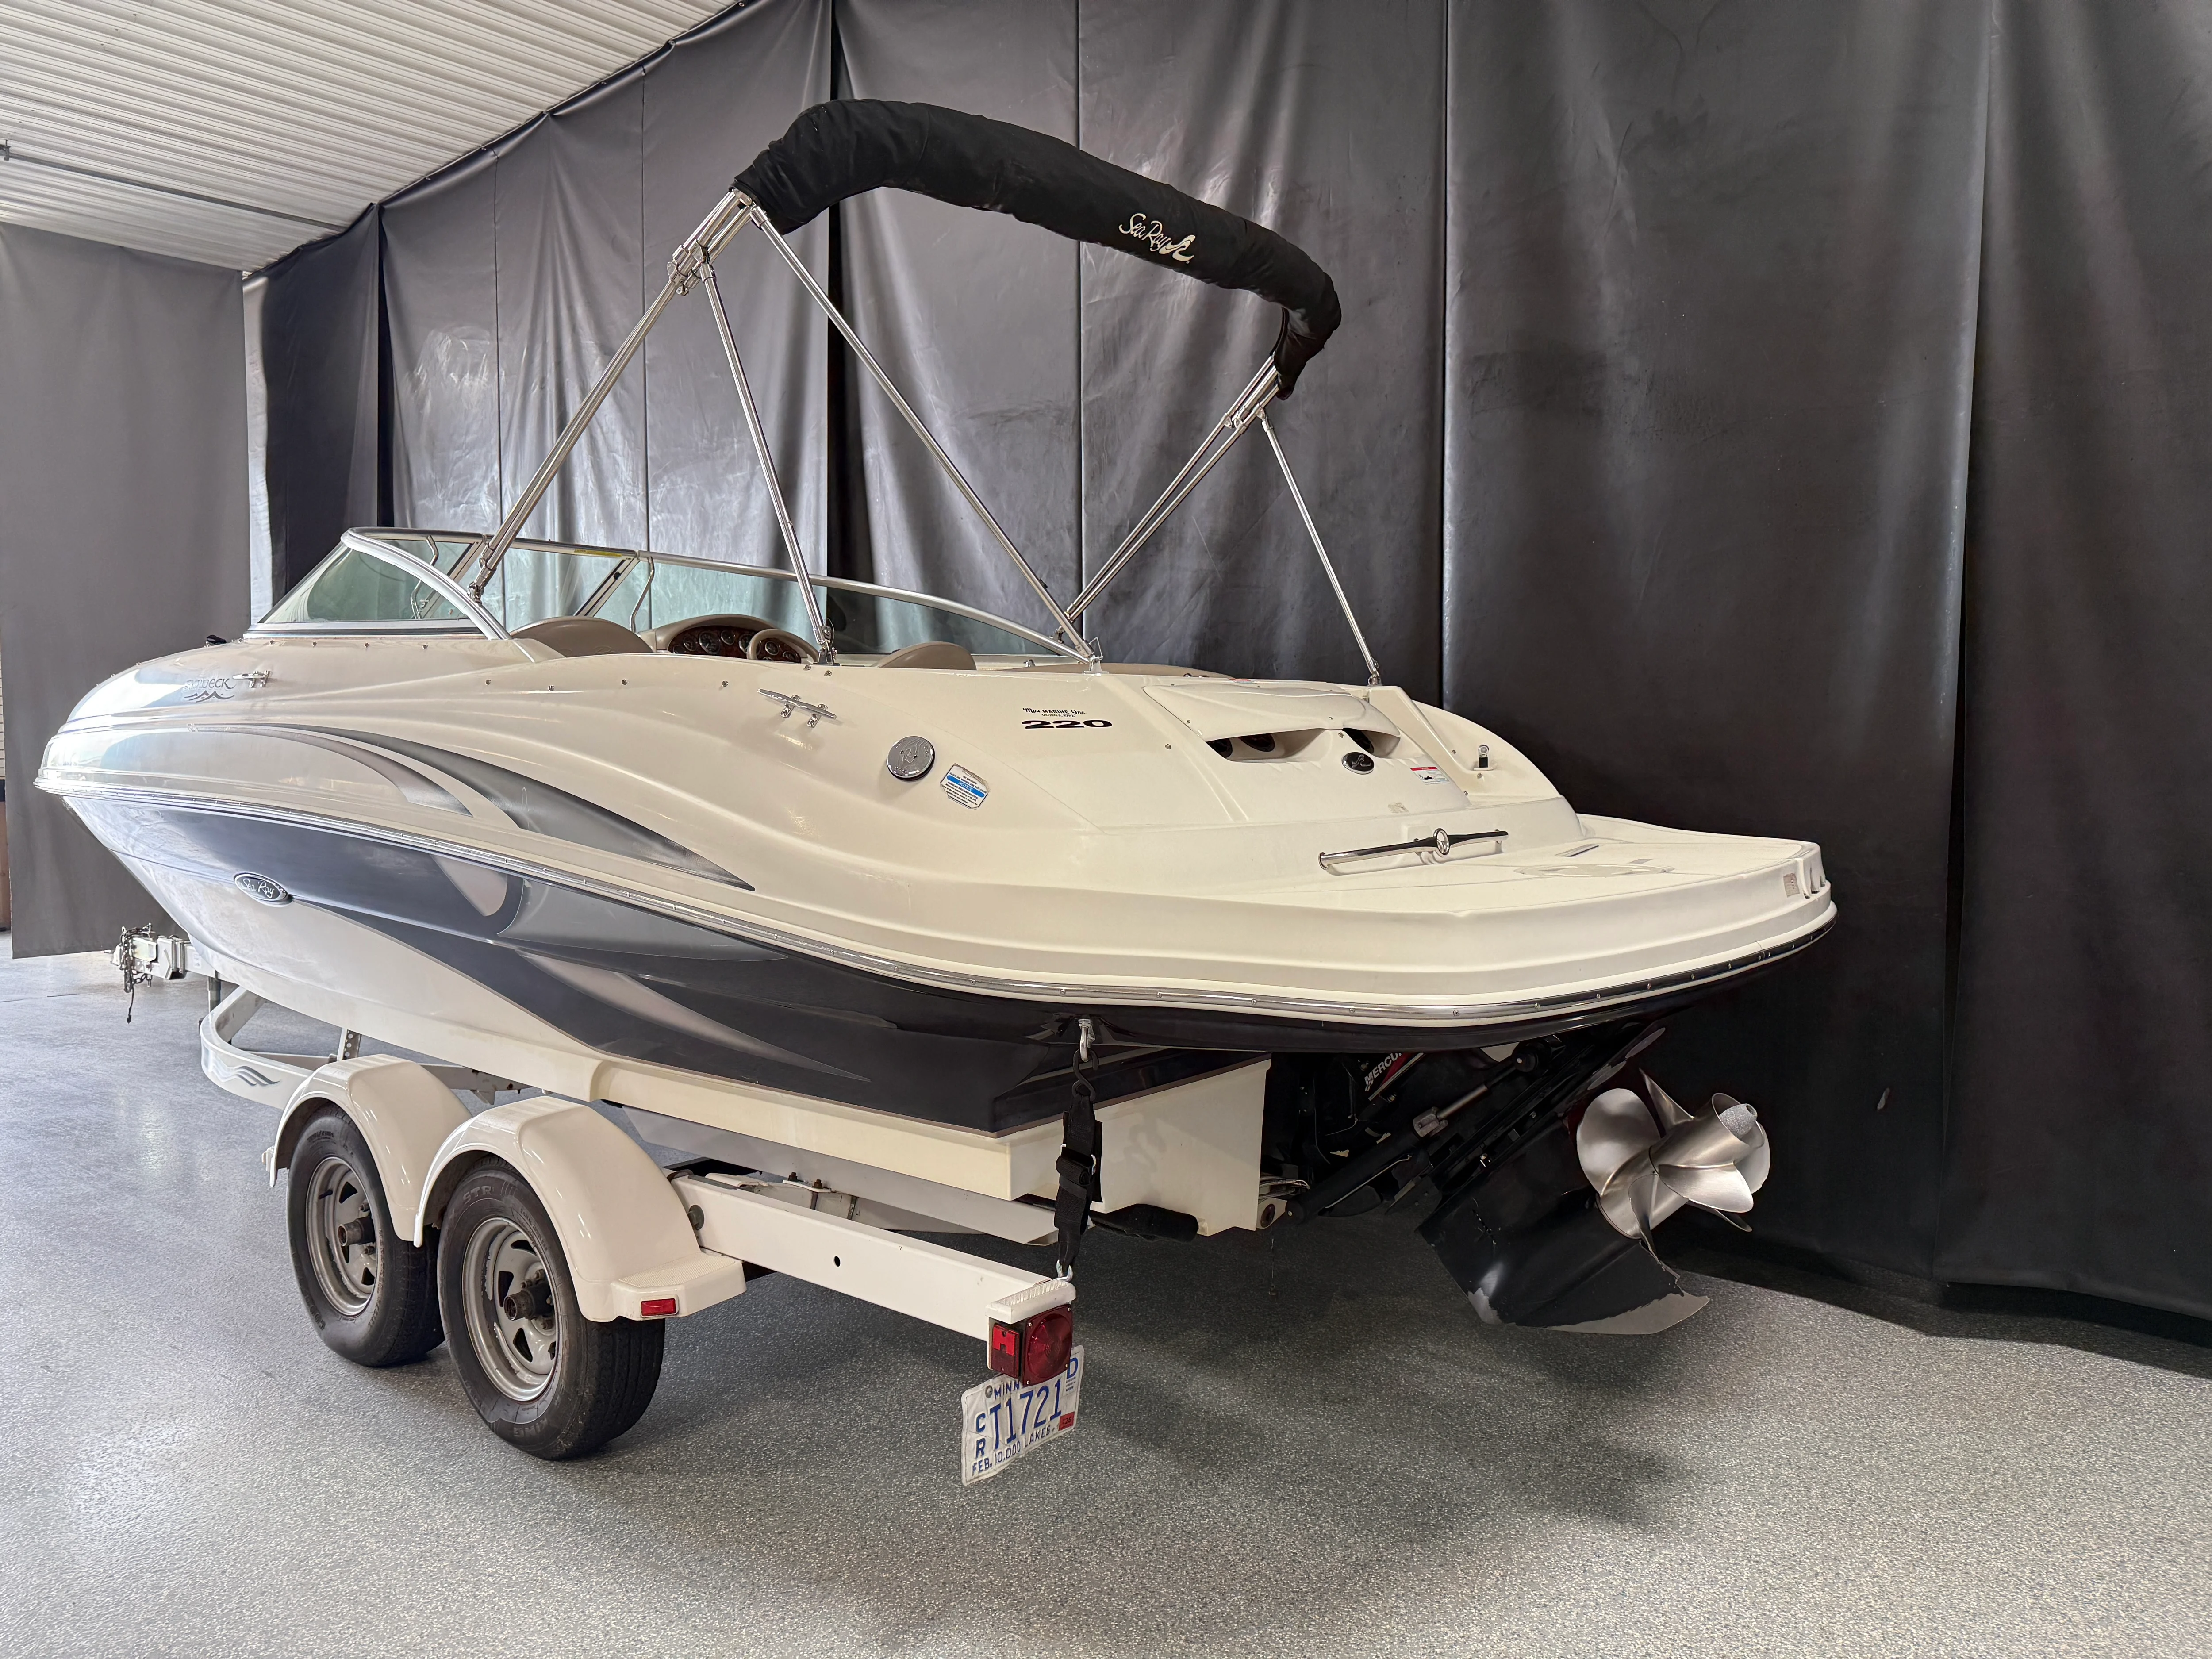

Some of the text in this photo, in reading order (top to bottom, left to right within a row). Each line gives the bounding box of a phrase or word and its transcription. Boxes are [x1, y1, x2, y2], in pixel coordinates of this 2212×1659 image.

[1118, 213, 1171, 252] Sea Ray
[1021, 719, 1113, 730] 220
[958, 781, 973, 792] NOTICE
[242, 878, 275, 899] Sea Ray
[1364, 1052, 1402, 1091] MERCU
[1066, 1357, 1078, 1379] D
[972, 1457, 993, 1476] FEB.
[995, 1440, 1021, 1465] 10,000
